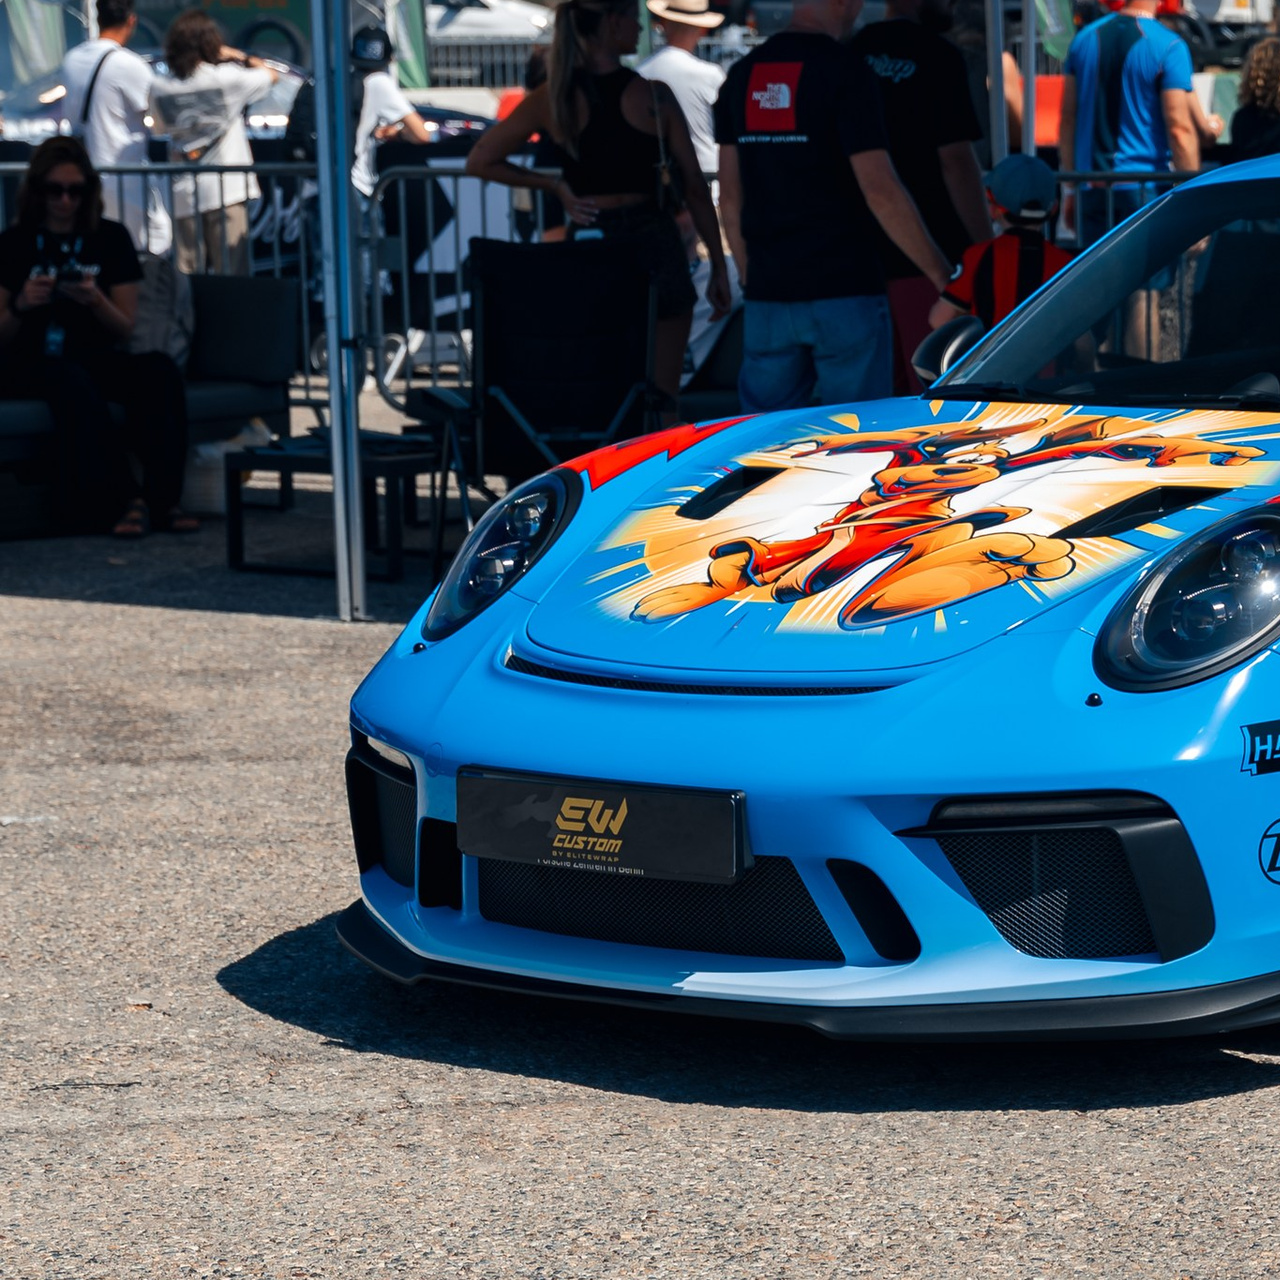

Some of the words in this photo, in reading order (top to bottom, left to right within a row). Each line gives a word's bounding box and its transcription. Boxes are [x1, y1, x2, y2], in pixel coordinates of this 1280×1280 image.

[555, 797, 628, 835] EW
[553, 834, 623, 853] CUSTOM
[566, 852, 620, 863] ELITEWRAP
